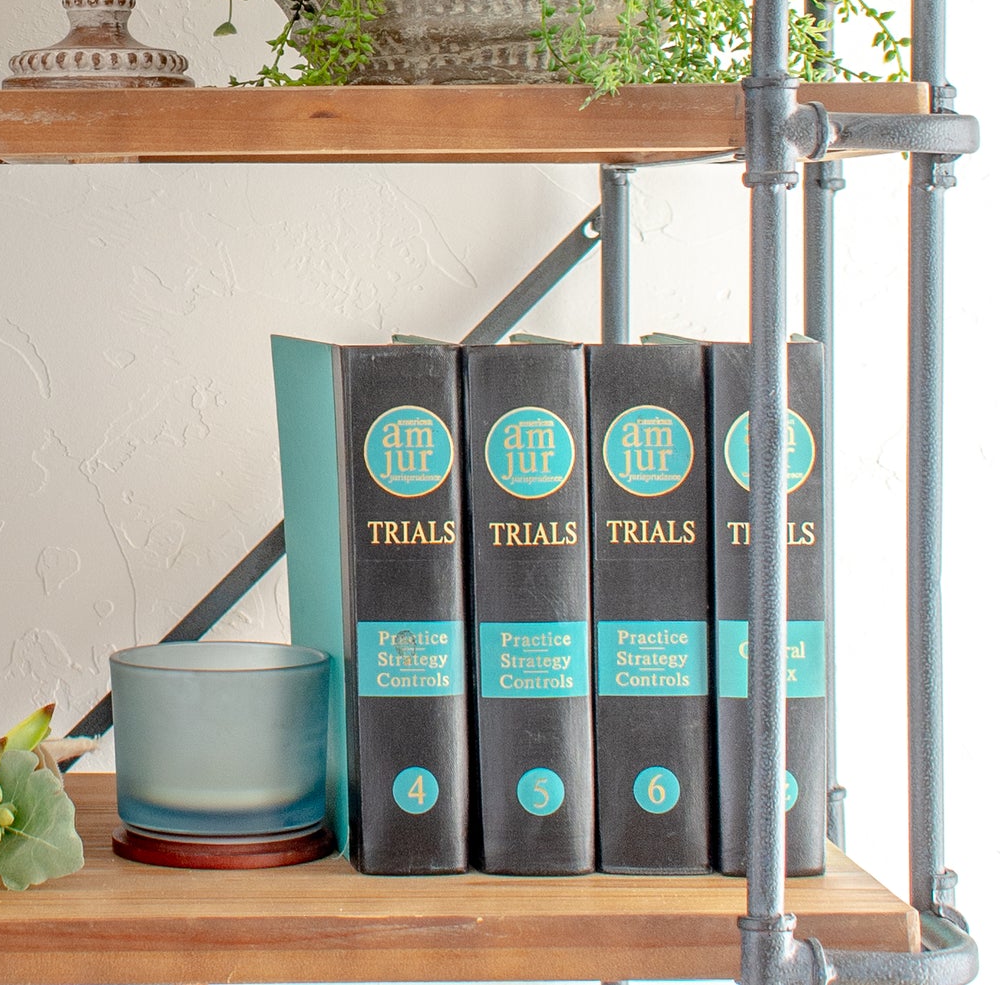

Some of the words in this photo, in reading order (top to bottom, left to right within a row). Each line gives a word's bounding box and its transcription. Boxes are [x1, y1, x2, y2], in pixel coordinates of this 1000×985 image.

[382, 422, 434, 448] am
[503, 423, 556, 449] am
[621, 421, 673, 448] am
[380, 449, 433, 479] jur
[501, 450, 554, 480] jur
[619, 448, 673, 478] jur
[367, 520, 456, 544] TRIALS
[489, 521, 578, 546] TRIALS
[606, 520, 696, 544] TRIALS
[727, 521, 816, 545] TLS
[378, 630, 449, 646] Practice
[501, 632, 572, 648] Practice
[617, 629, 688, 645] Practice
[377, 651, 449, 668] Strategy
[501, 653, 572, 670] Strategy
[616, 650, 688, 668] Strategy
[377, 672, 450, 688] Controls
[500, 674, 574, 689] Controls
[615, 672, 690, 687] Controls
[407, 775, 426, 805] 4
[533, 777, 550, 809] 5
[647, 774, 666, 805] 6
